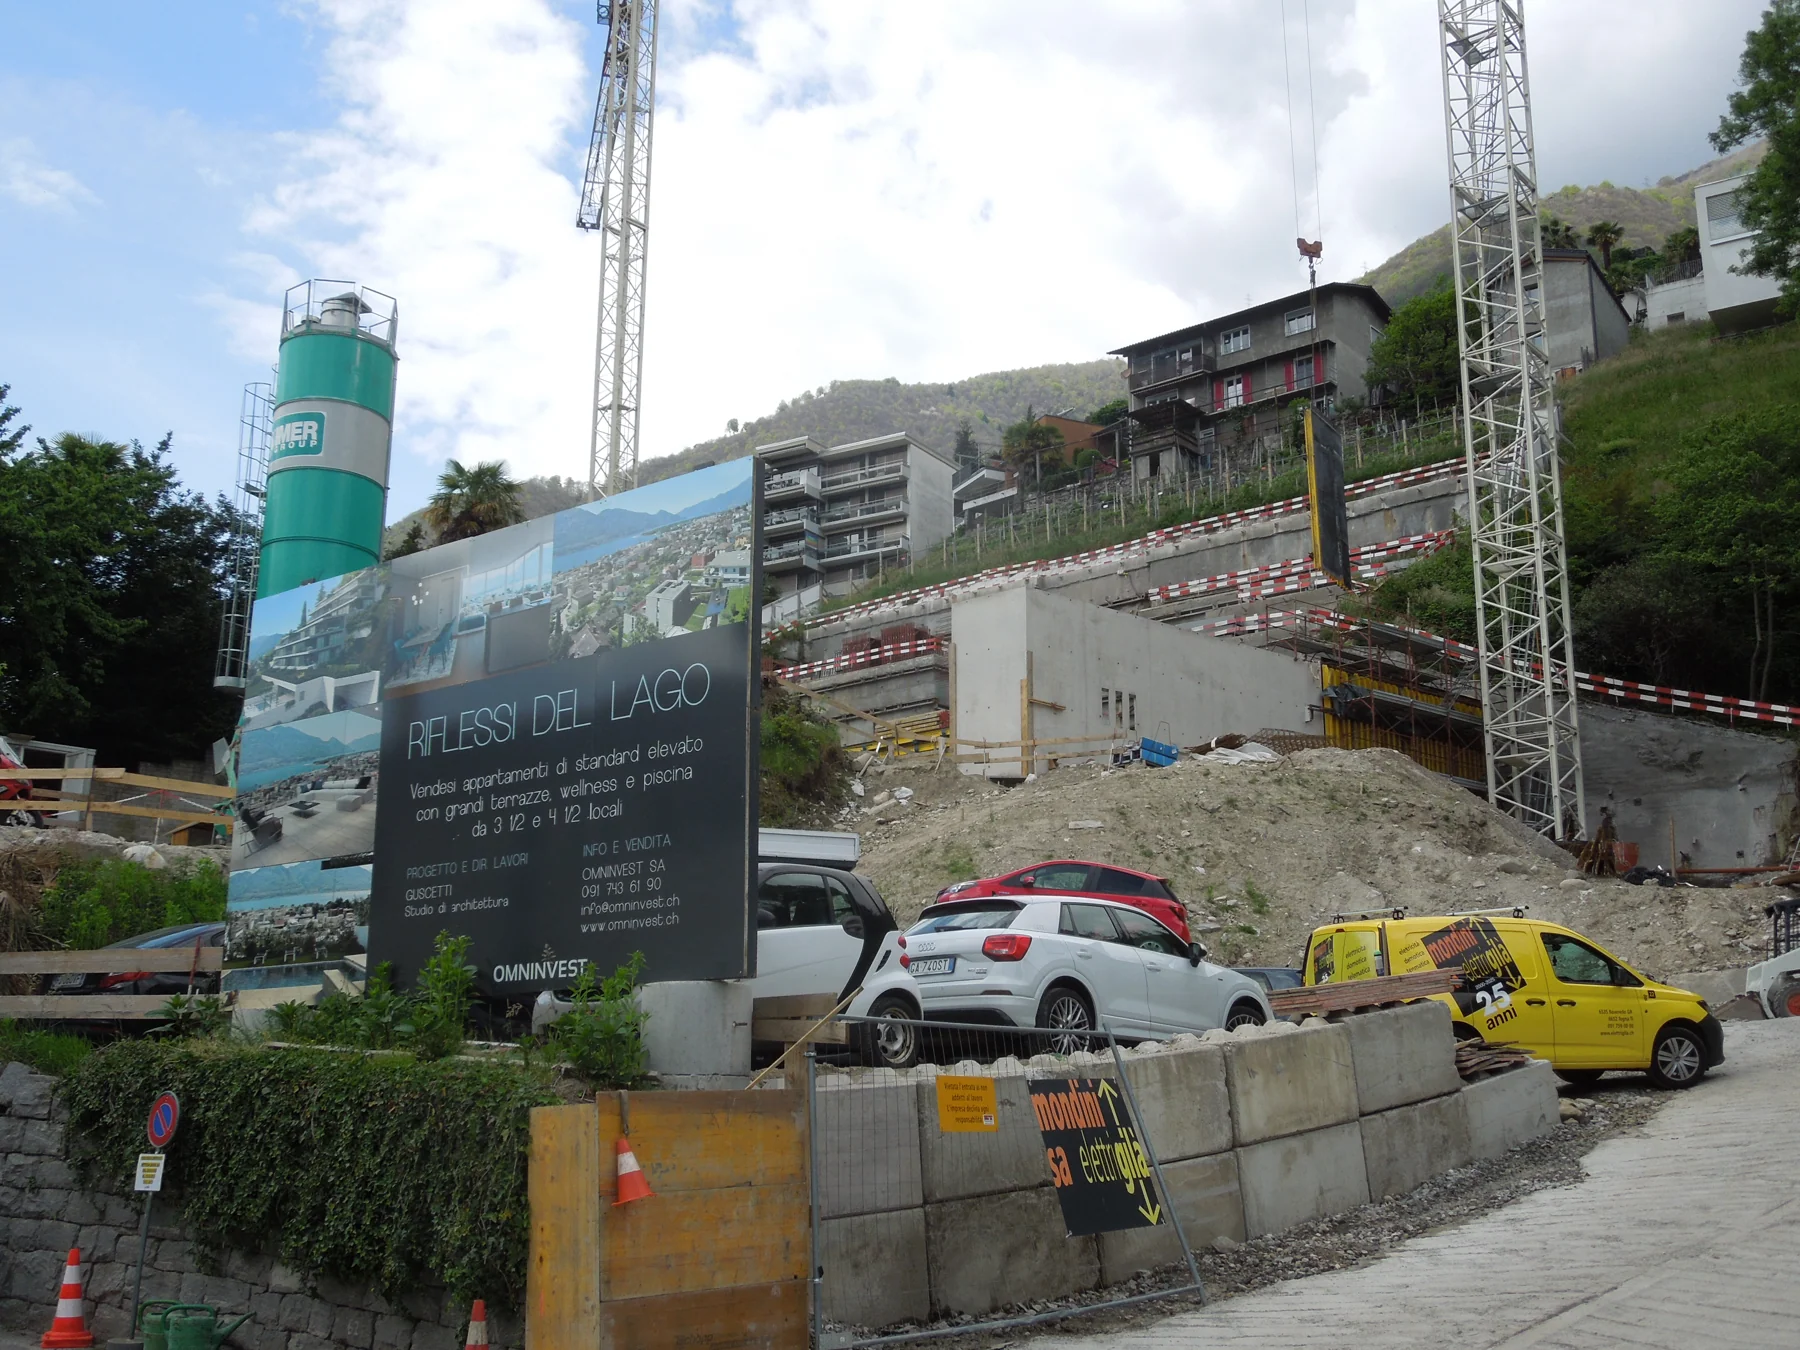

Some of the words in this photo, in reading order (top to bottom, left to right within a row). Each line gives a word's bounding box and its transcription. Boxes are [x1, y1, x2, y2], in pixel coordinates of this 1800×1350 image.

[407, 702, 517, 760] RIFLESSI
[533, 688, 591, 736] DEL
[611, 663, 710, 721] LAGO
[410, 779, 456, 800] Vendesi
[462, 761, 549, 795] appartamenti
[556, 757, 568, 775] di
[575, 744, 640, 771] standard
[648, 735, 703, 759] elevato
[416, 807, 439, 822] con
[445, 796, 484, 822] grandi
[560, 778, 617, 799] wellness
[625, 775, 635, 789] e
[643, 766, 693, 791] piscina
[472, 820, 487, 837] da
[494, 816, 502, 834] 3
[532, 815, 541, 828] e
[548, 807, 557, 825] 4
[589, 798, 623, 820] locali
[583, 842, 607, 857] INFO
[613, 840, 619, 854] E
[625, 833, 672, 852] VENDITA
[406, 862, 457, 880] PROGETTO
[461, 860, 468, 873] E
[493, 852, 529, 869] LAVORI
[582, 861, 644, 881] OMNINVEST
[649, 859, 666, 873] SA
[405, 884, 453, 901] GUSCETTI
[581, 884, 600, 898] 091
[606, 881, 624, 896] 743
[629, 880, 640, 893] 61
[646, 877, 662, 891] 90
[404, 903, 434, 917] Studio
[438, 902, 447, 913] di
[451, 896, 509, 913] architettura
[581, 893, 680, 916] info@omninvest.ch
[581, 912, 679, 933] www.omninvest.ch
[1427, 919, 1478, 965] mondini
[493, 959, 588, 983] OMNINVEST
[1476, 982, 1512, 1017] 25
[1486, 1004, 1517, 1030] anni
[1030, 1079, 1106, 1131] mondini
[1047, 1146, 1074, 1188] sa
